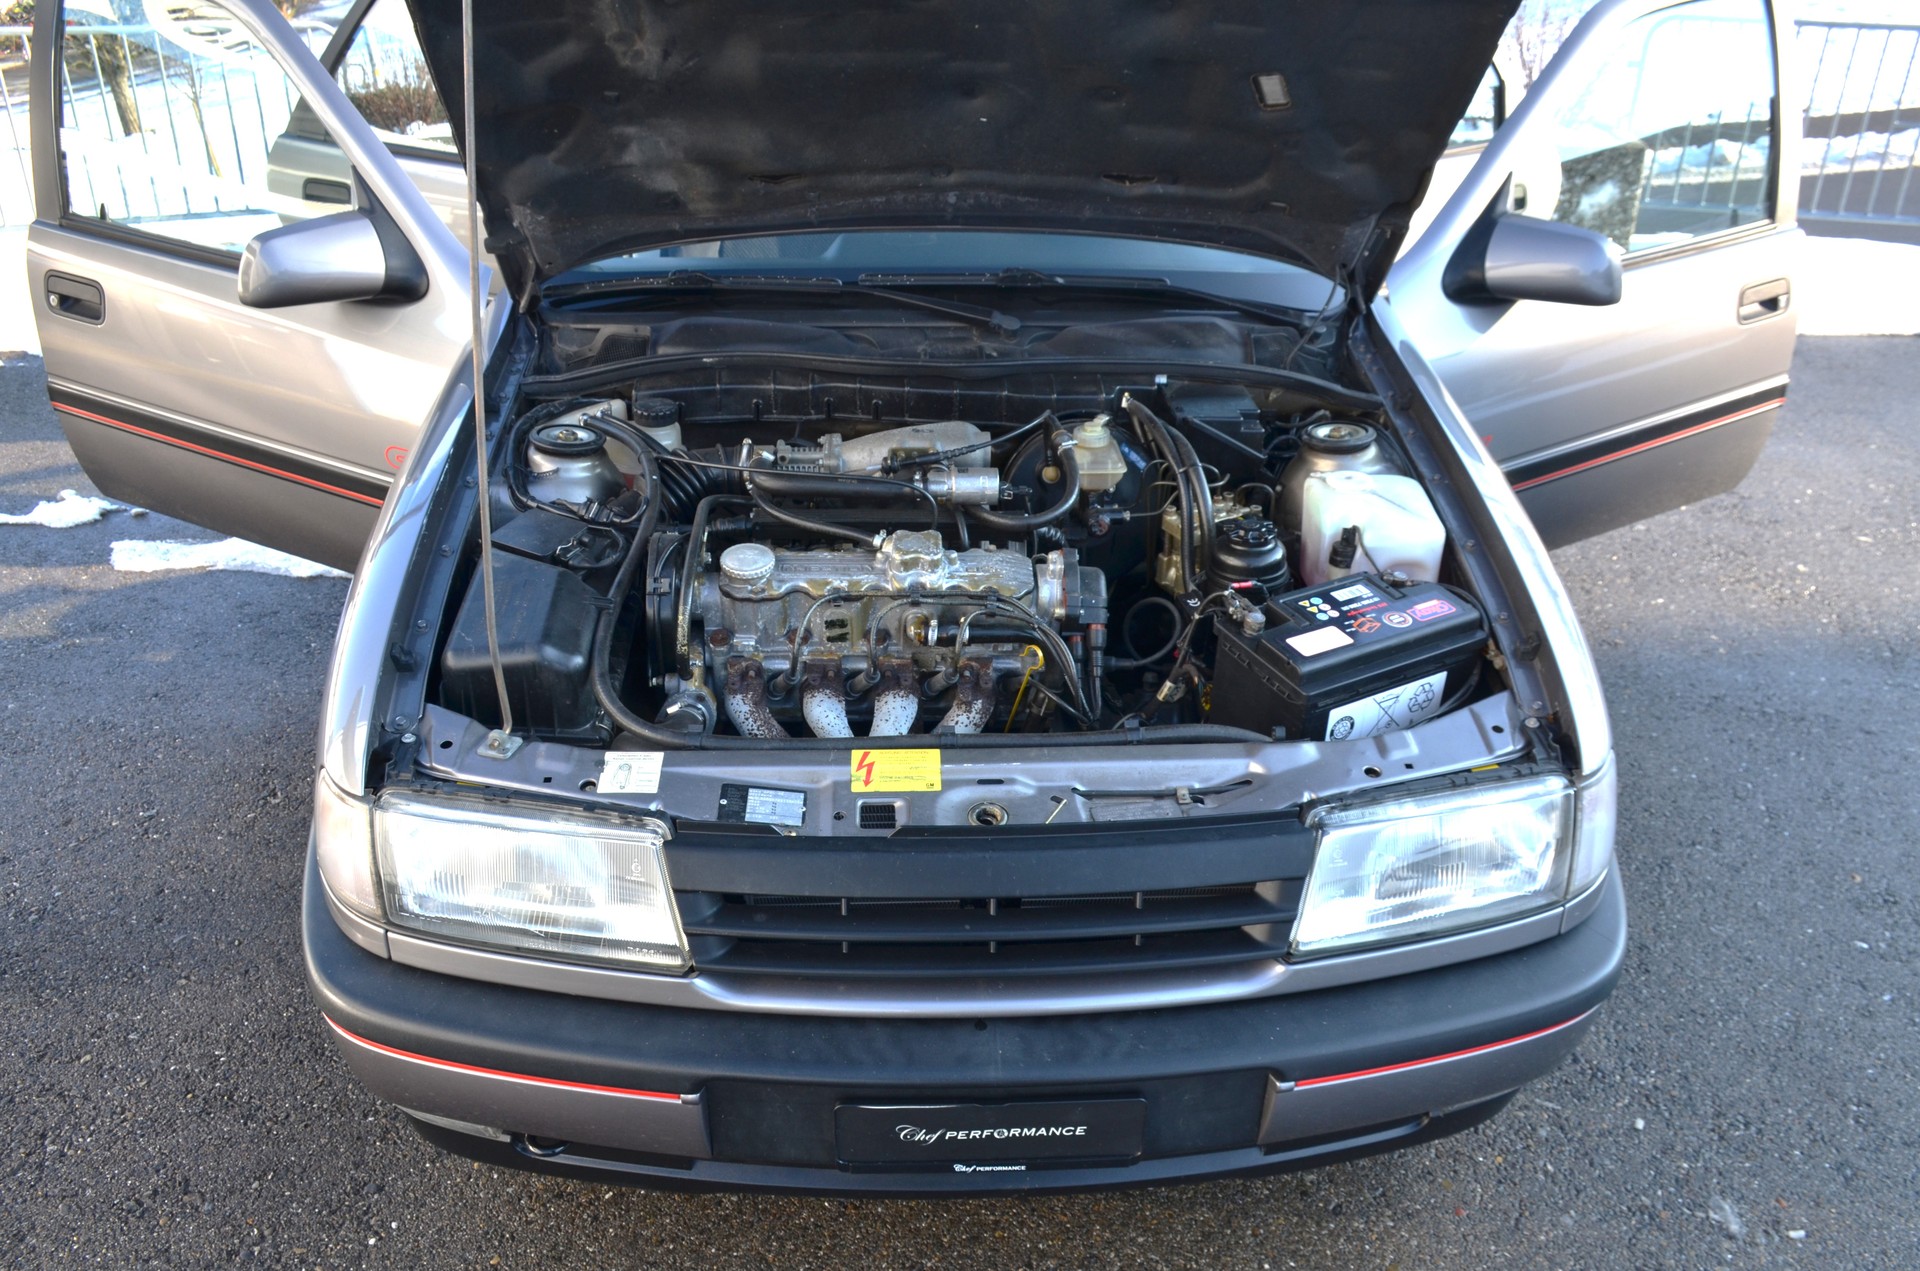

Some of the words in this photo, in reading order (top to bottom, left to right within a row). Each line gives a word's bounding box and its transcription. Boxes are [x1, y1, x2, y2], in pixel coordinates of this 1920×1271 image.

[895, 1124, 946, 1146] Chef
[945, 1126, 1087, 1140] PERFORMANCE
[953, 1164, 977, 1173] Chef
